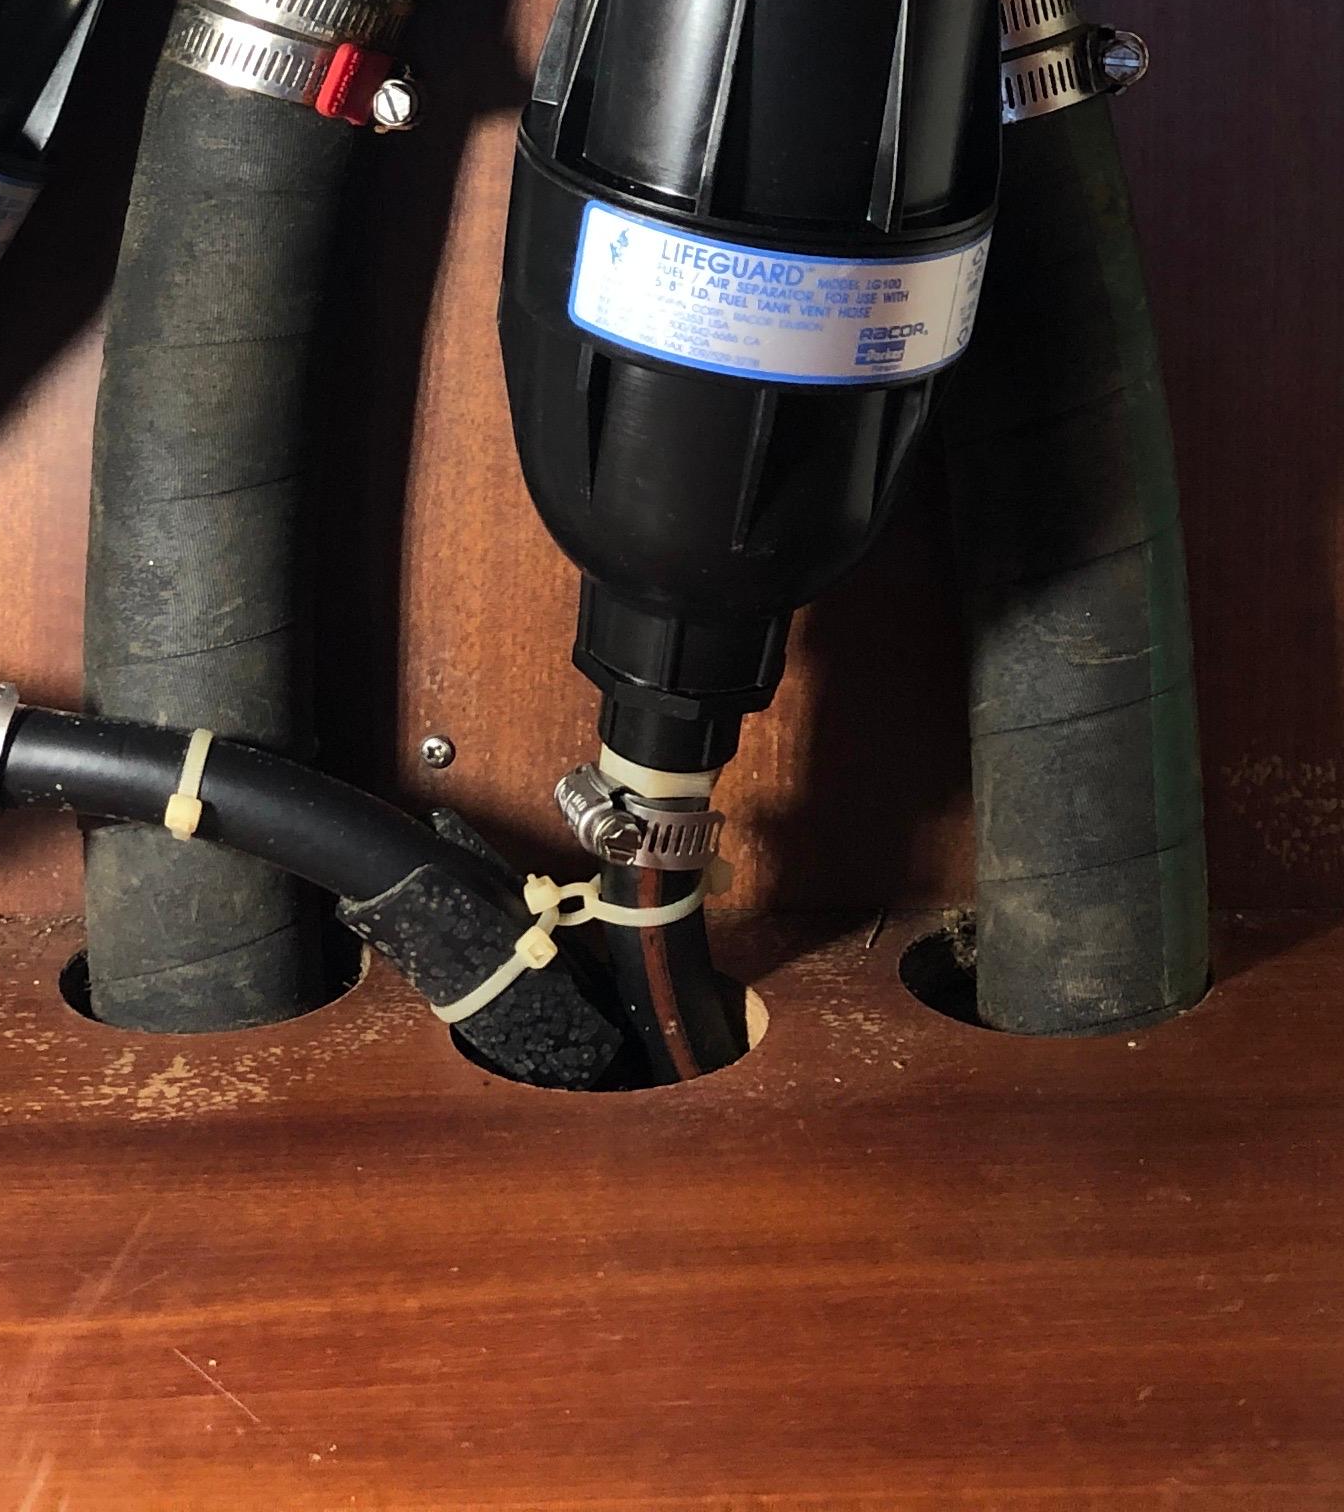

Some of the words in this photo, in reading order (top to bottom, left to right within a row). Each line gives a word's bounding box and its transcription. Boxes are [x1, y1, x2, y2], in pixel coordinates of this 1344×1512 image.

[661, 239, 805, 286] LIFEGUARD
[707, 276, 730, 290] AIR
[736, 281, 815, 302] SEPARATOR
[825, 292, 849, 304] FOR
[856, 292, 878, 304] USE
[883, 291, 909, 303] WITH
[719, 292, 748, 308] FUEL
[757, 299, 791, 314] TANK
[800, 305, 831, 317] VENT
[838, 306, 873, 318] HOSE
